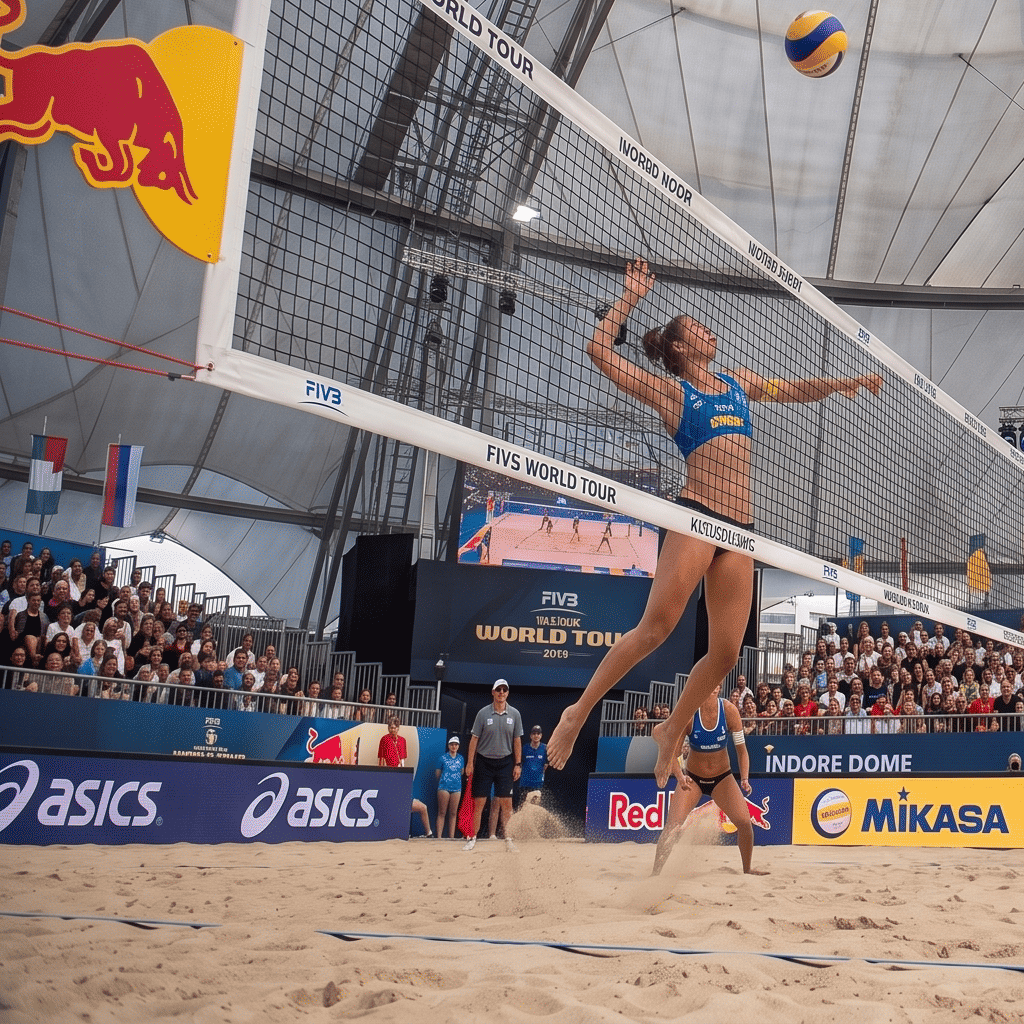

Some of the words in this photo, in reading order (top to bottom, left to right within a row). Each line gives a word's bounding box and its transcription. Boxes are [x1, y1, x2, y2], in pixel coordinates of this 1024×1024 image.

[487, 28, 534, 81] TOUR
[486, 444, 521, 471] FIVS
[525, 457, 577, 490] WORLD
[580, 476, 617, 505] TOUR
[475, 624, 567, 645] WORLD
[571, 629, 622, 647] TOU
[765, 754, 843, 773] INDORE
[848, 754, 913, 773] DOME
[37, 778, 162, 827] asics
[287, 787, 379, 827] asics
[609, 791, 666, 831] Red
